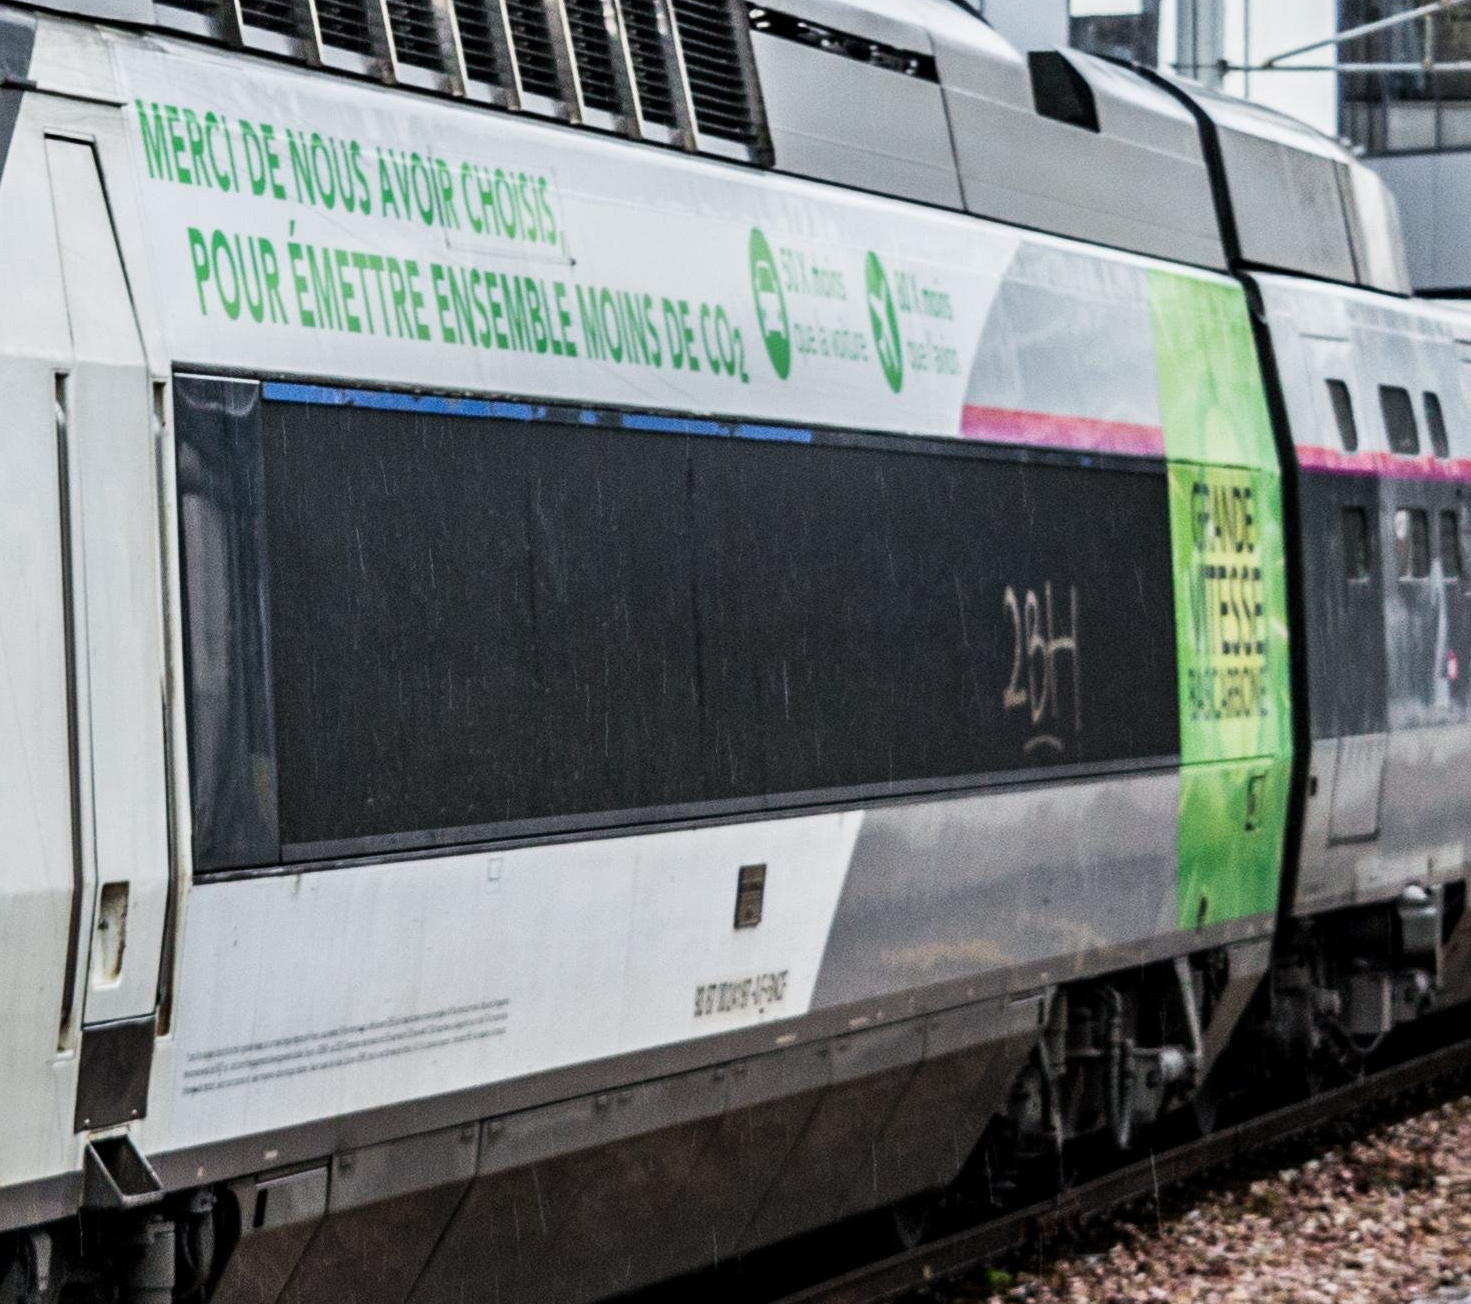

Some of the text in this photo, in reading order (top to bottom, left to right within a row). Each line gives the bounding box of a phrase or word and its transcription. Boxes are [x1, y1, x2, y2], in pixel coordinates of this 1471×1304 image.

[136, 99, 239, 193] MERCI
[238, 119, 287, 201] DE
[286, 128, 371, 215] NOUS
[376, 145, 461, 230] AVOIR
[187, 226, 289, 325] POUR
[287, 219, 432, 341] ÉMETTRE
[430, 263, 578, 357] ENSEMBLE
[575, 284, 662, 369] MOINS
[661, 297, 700, 372] DE
